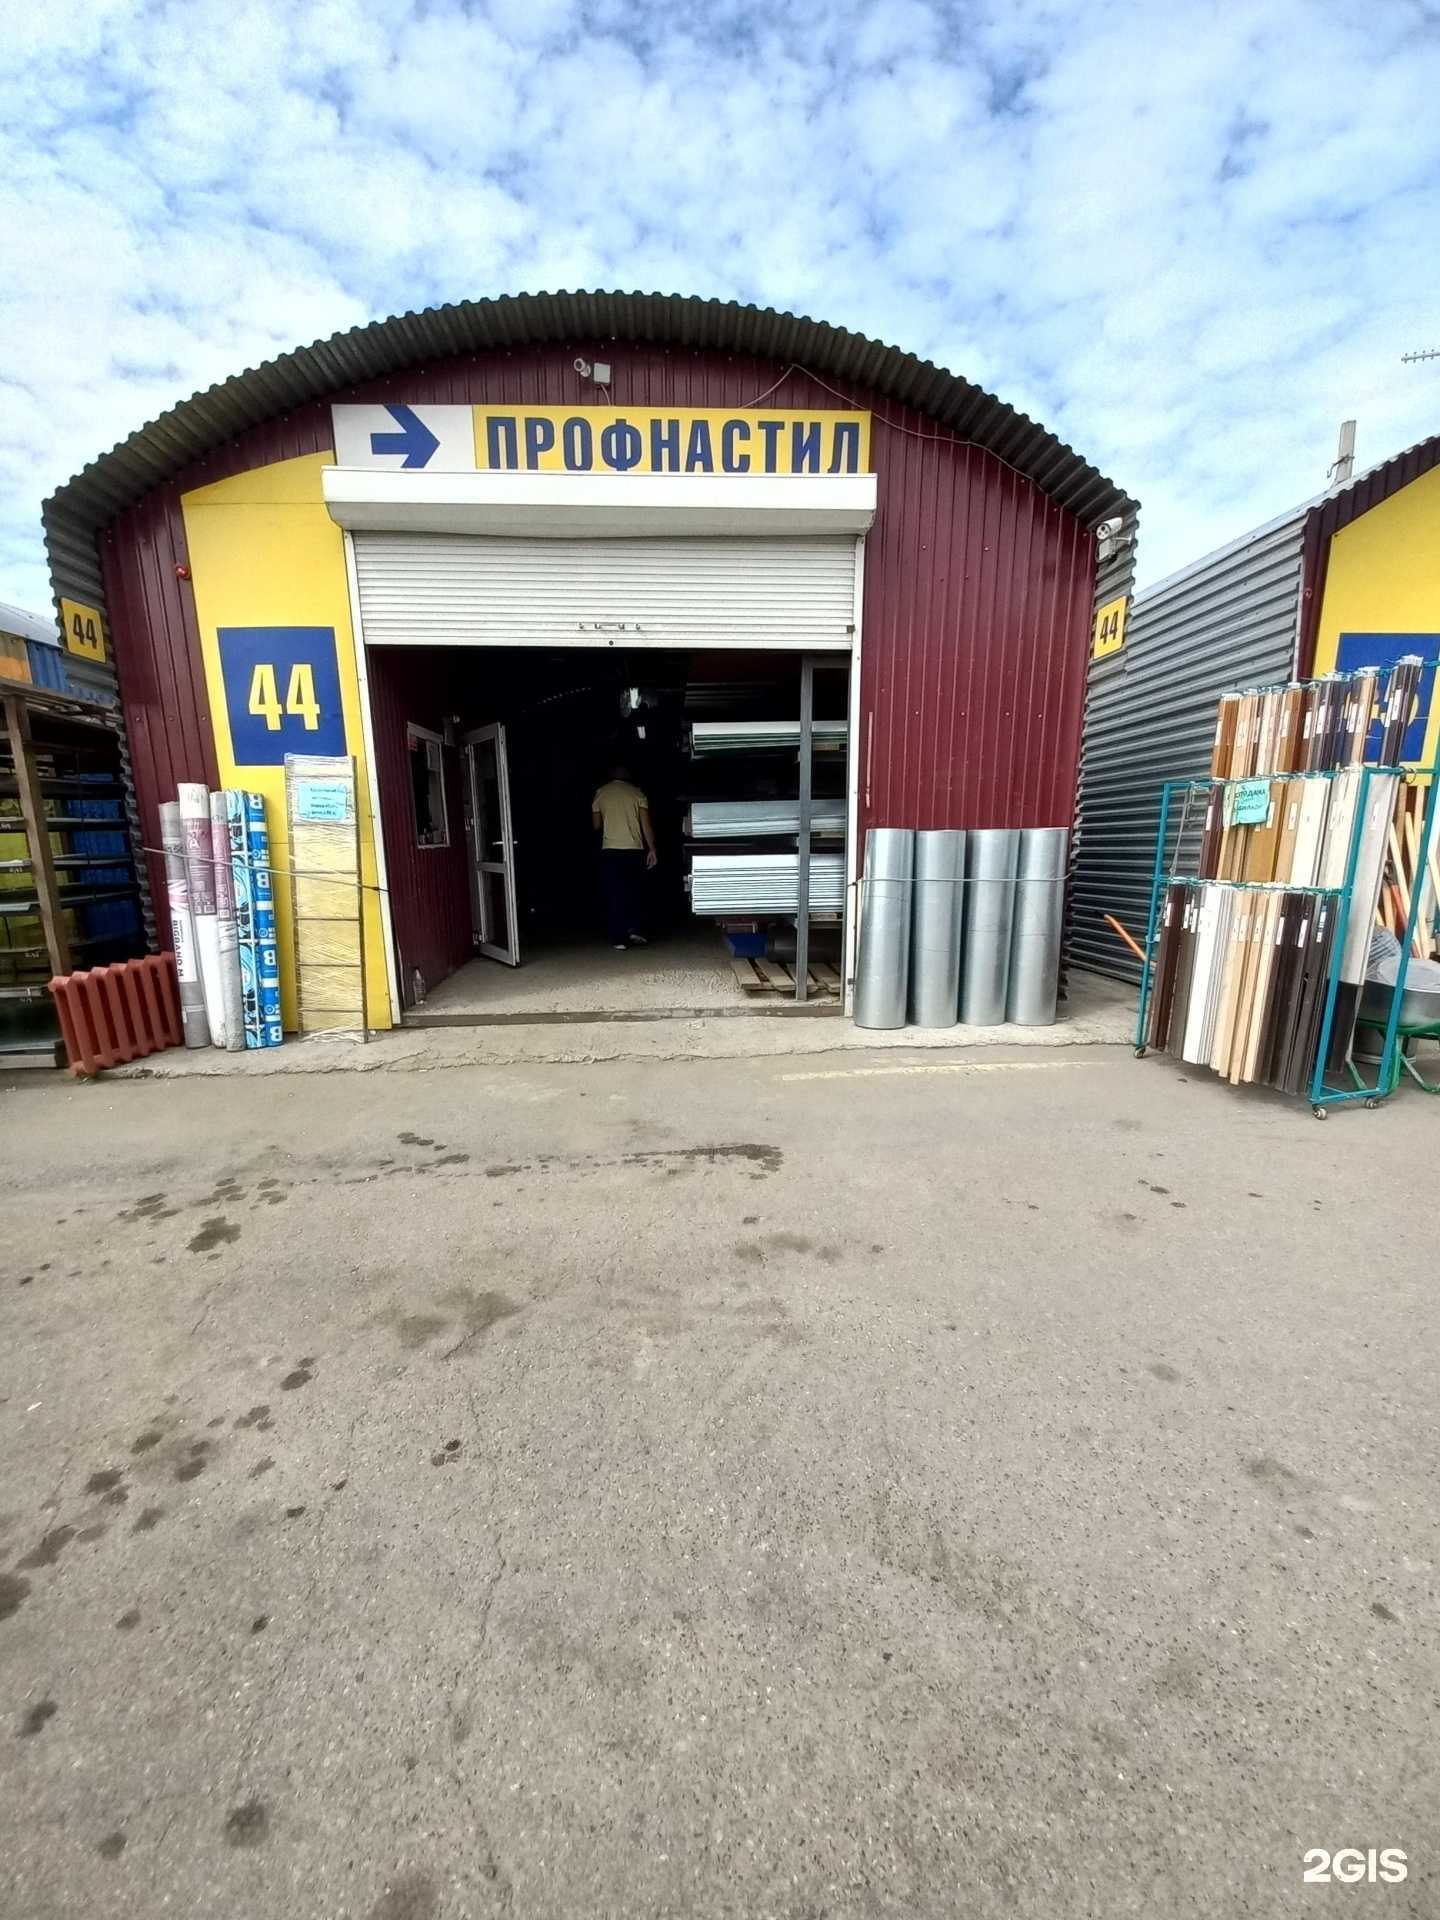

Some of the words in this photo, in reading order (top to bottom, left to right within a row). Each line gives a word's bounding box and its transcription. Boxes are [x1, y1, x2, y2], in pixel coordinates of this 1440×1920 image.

[486, 415, 859, 473] ПРОФНАСТИЛ
[73, 613, 97, 649] 44
[1100, 610, 1118, 644] 44
[249, 664, 320, 730] 44
